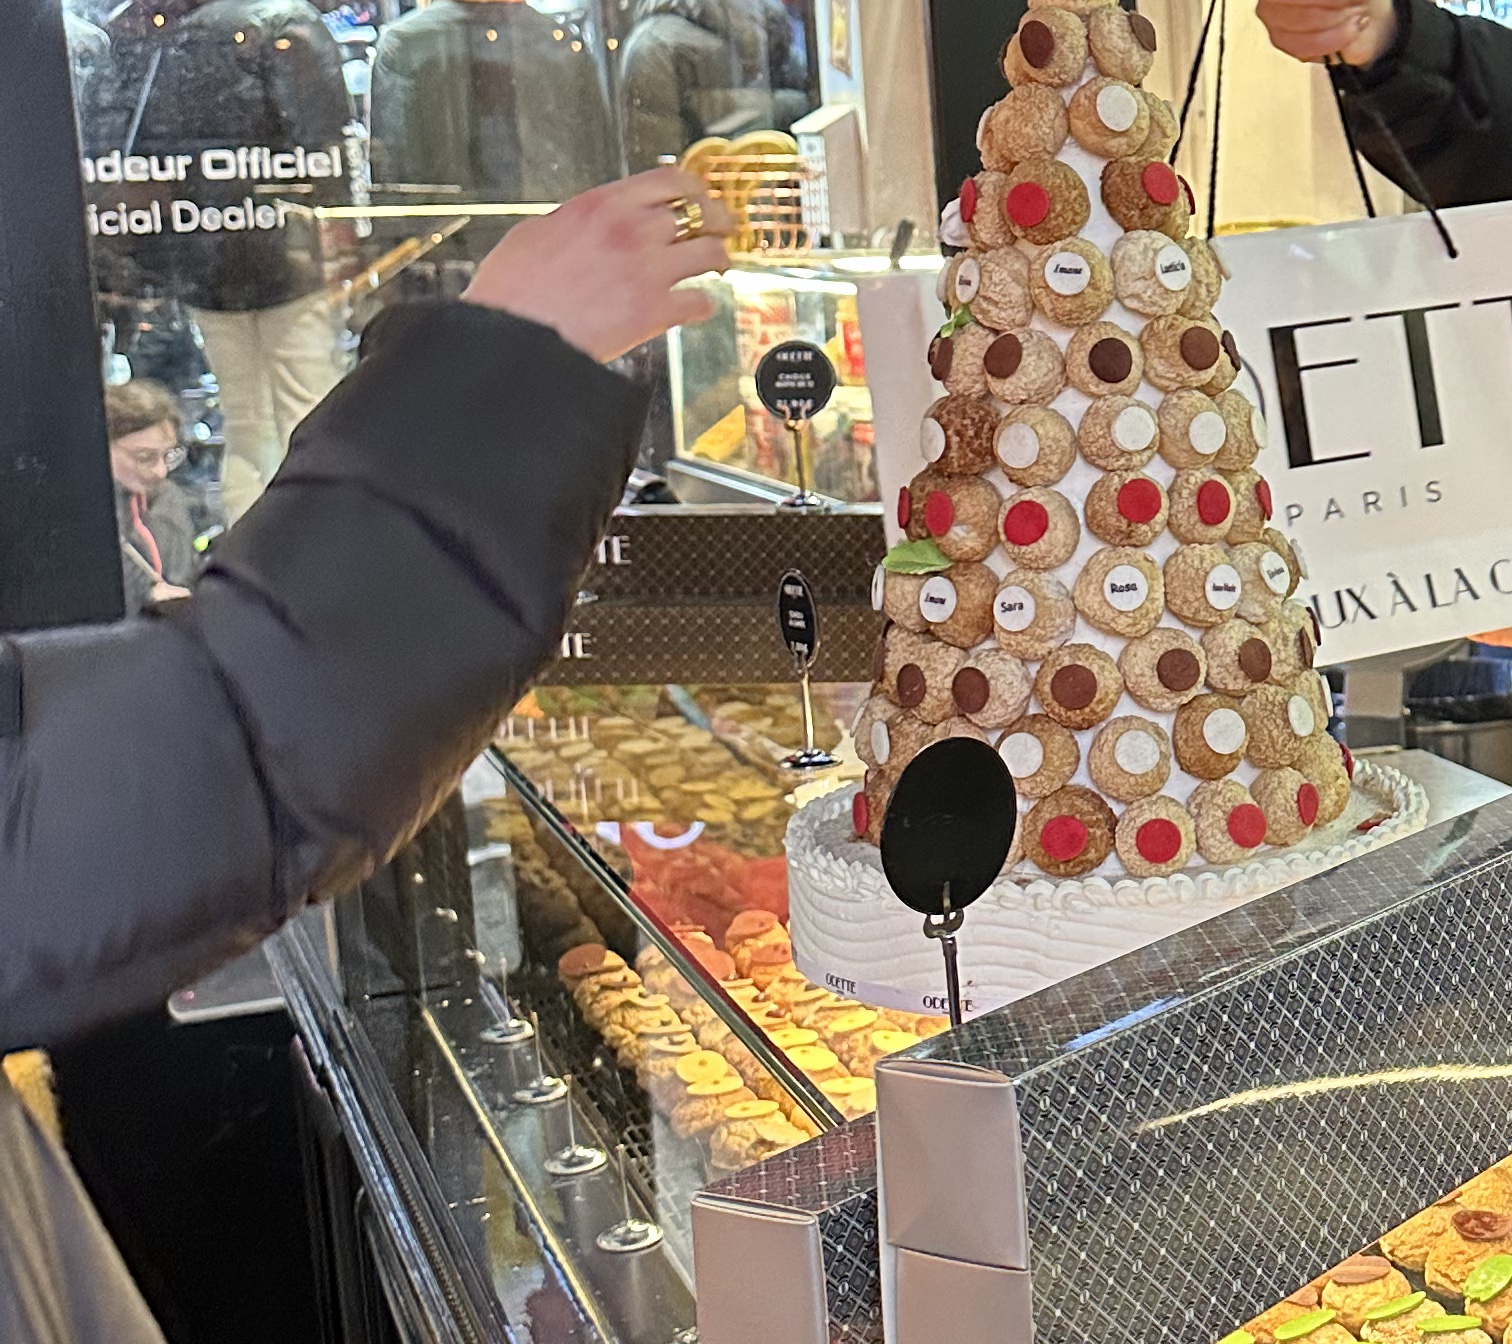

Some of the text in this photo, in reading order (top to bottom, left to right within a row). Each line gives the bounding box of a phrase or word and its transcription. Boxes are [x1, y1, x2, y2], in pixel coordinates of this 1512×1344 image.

[171, 196, 287, 233] Dealer
[1286, 480, 1444, 526] PARIS
[1110, 582, 1138, 594] Rosa
[1386, 571, 1418, 617] À
[1424, 567, 1481, 609] LA
[1000, 601, 1024, 613] Sara
